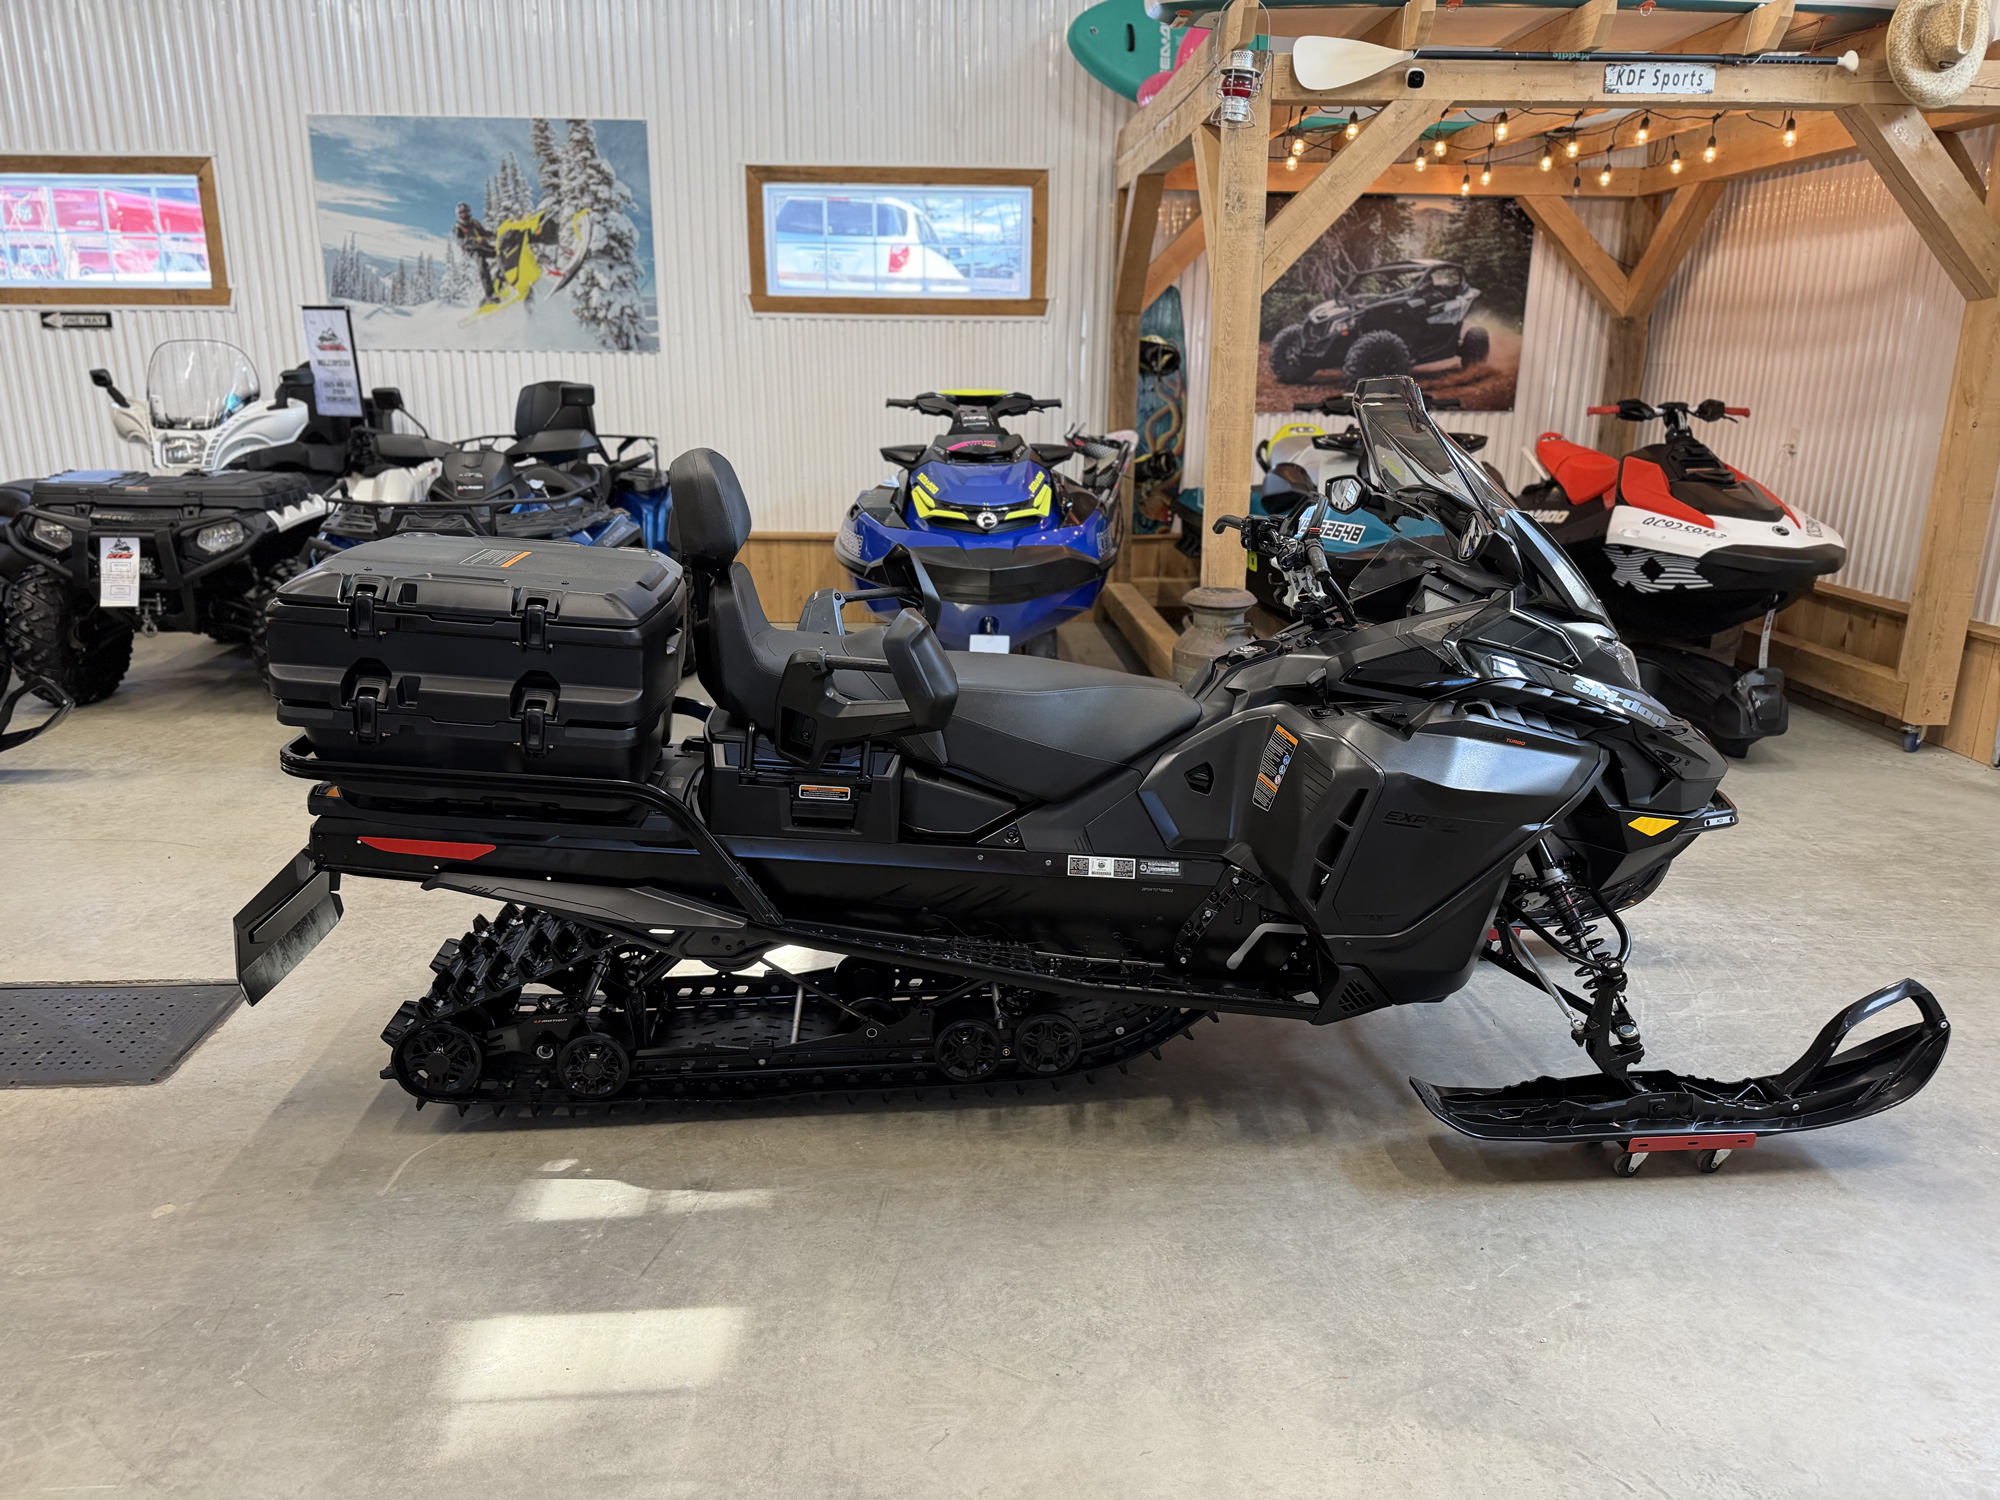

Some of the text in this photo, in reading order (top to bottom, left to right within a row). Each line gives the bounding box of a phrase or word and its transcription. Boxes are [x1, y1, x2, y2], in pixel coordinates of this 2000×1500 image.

[1616, 69, 1704, 91] KDF Sports
[1505, 736, 1526, 747] TURBO
